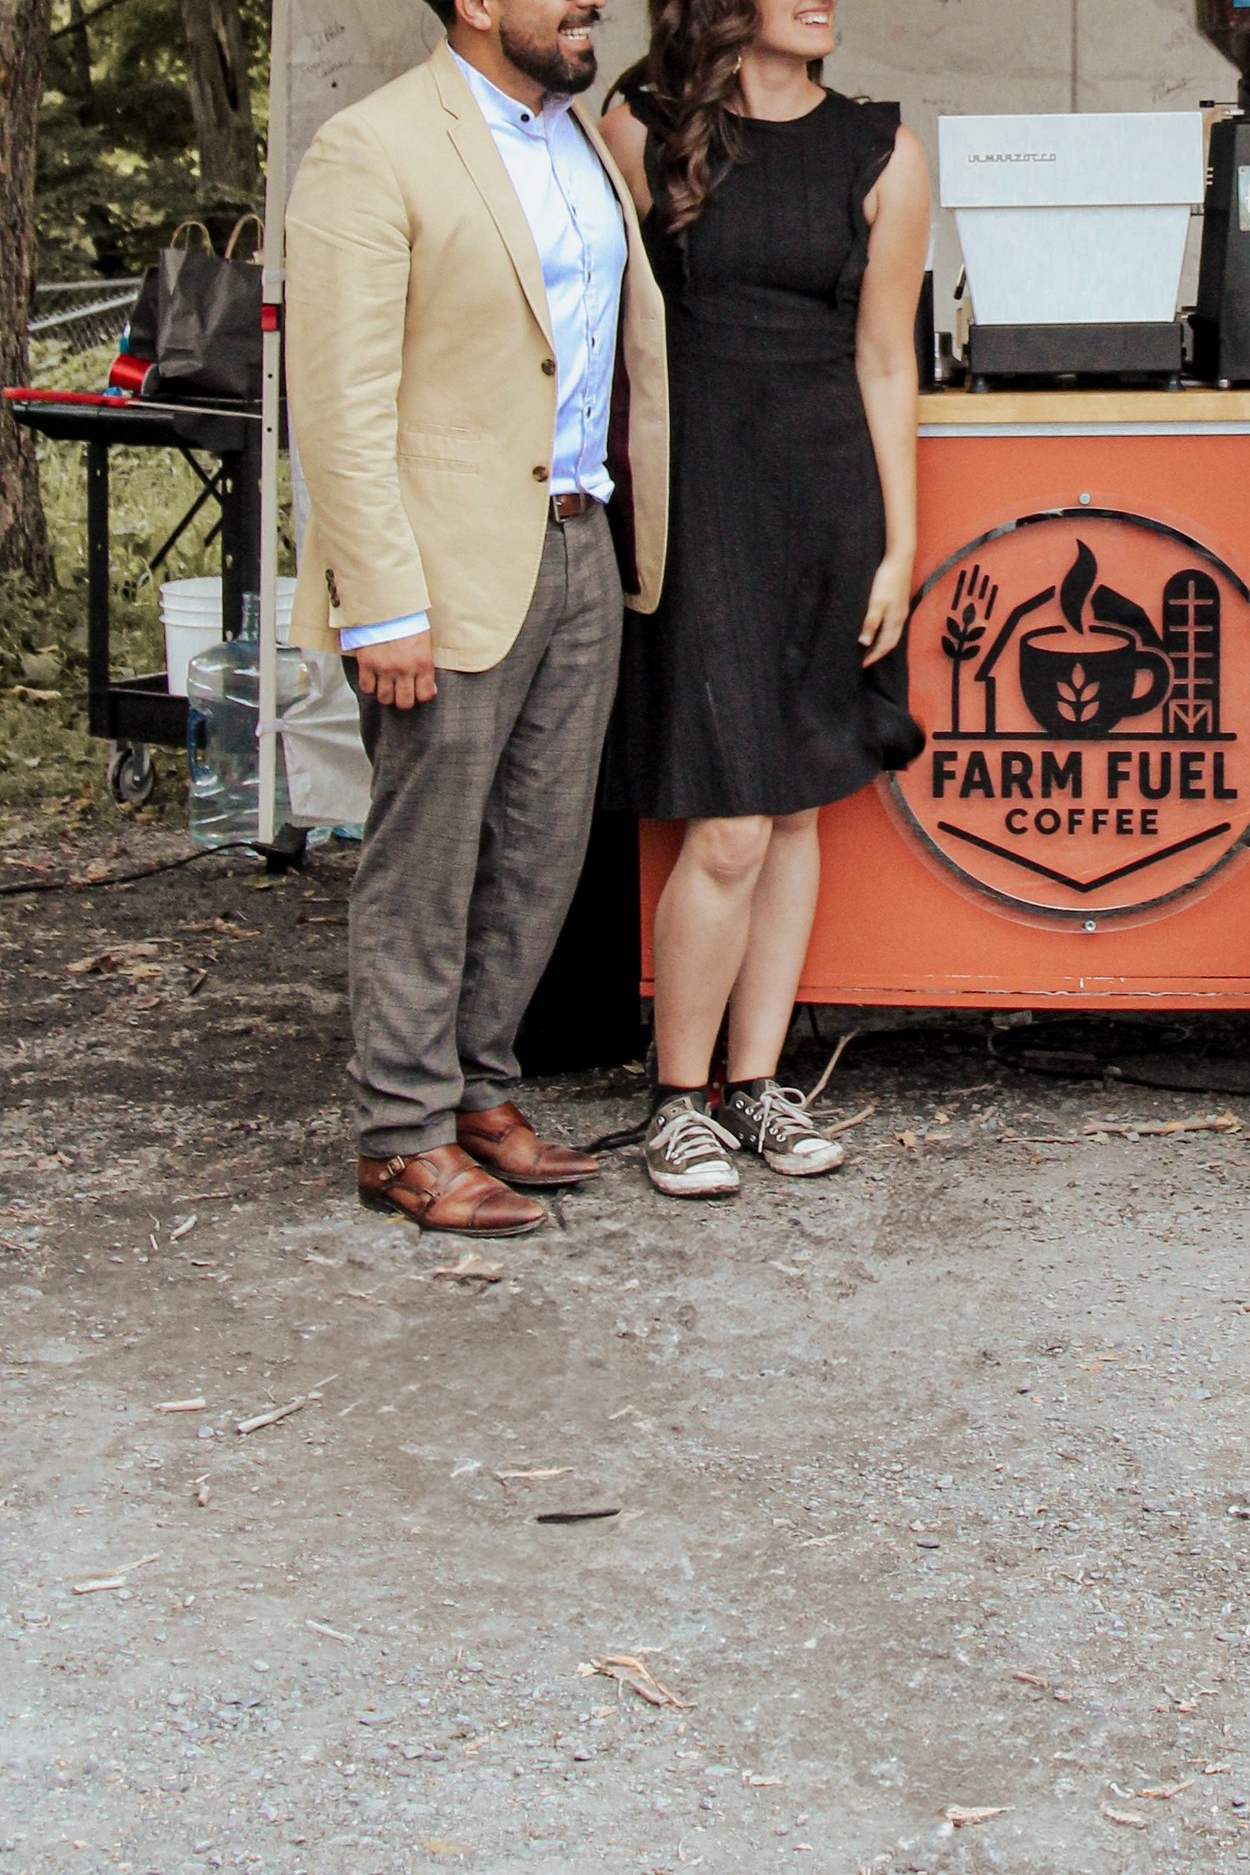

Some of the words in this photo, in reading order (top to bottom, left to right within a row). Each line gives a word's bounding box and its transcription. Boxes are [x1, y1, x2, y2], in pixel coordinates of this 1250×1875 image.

[932, 751, 1083, 799] FARM
[1106, 751, 1238, 800] FUEL
[1005, 808, 1159, 835] COFFEE
